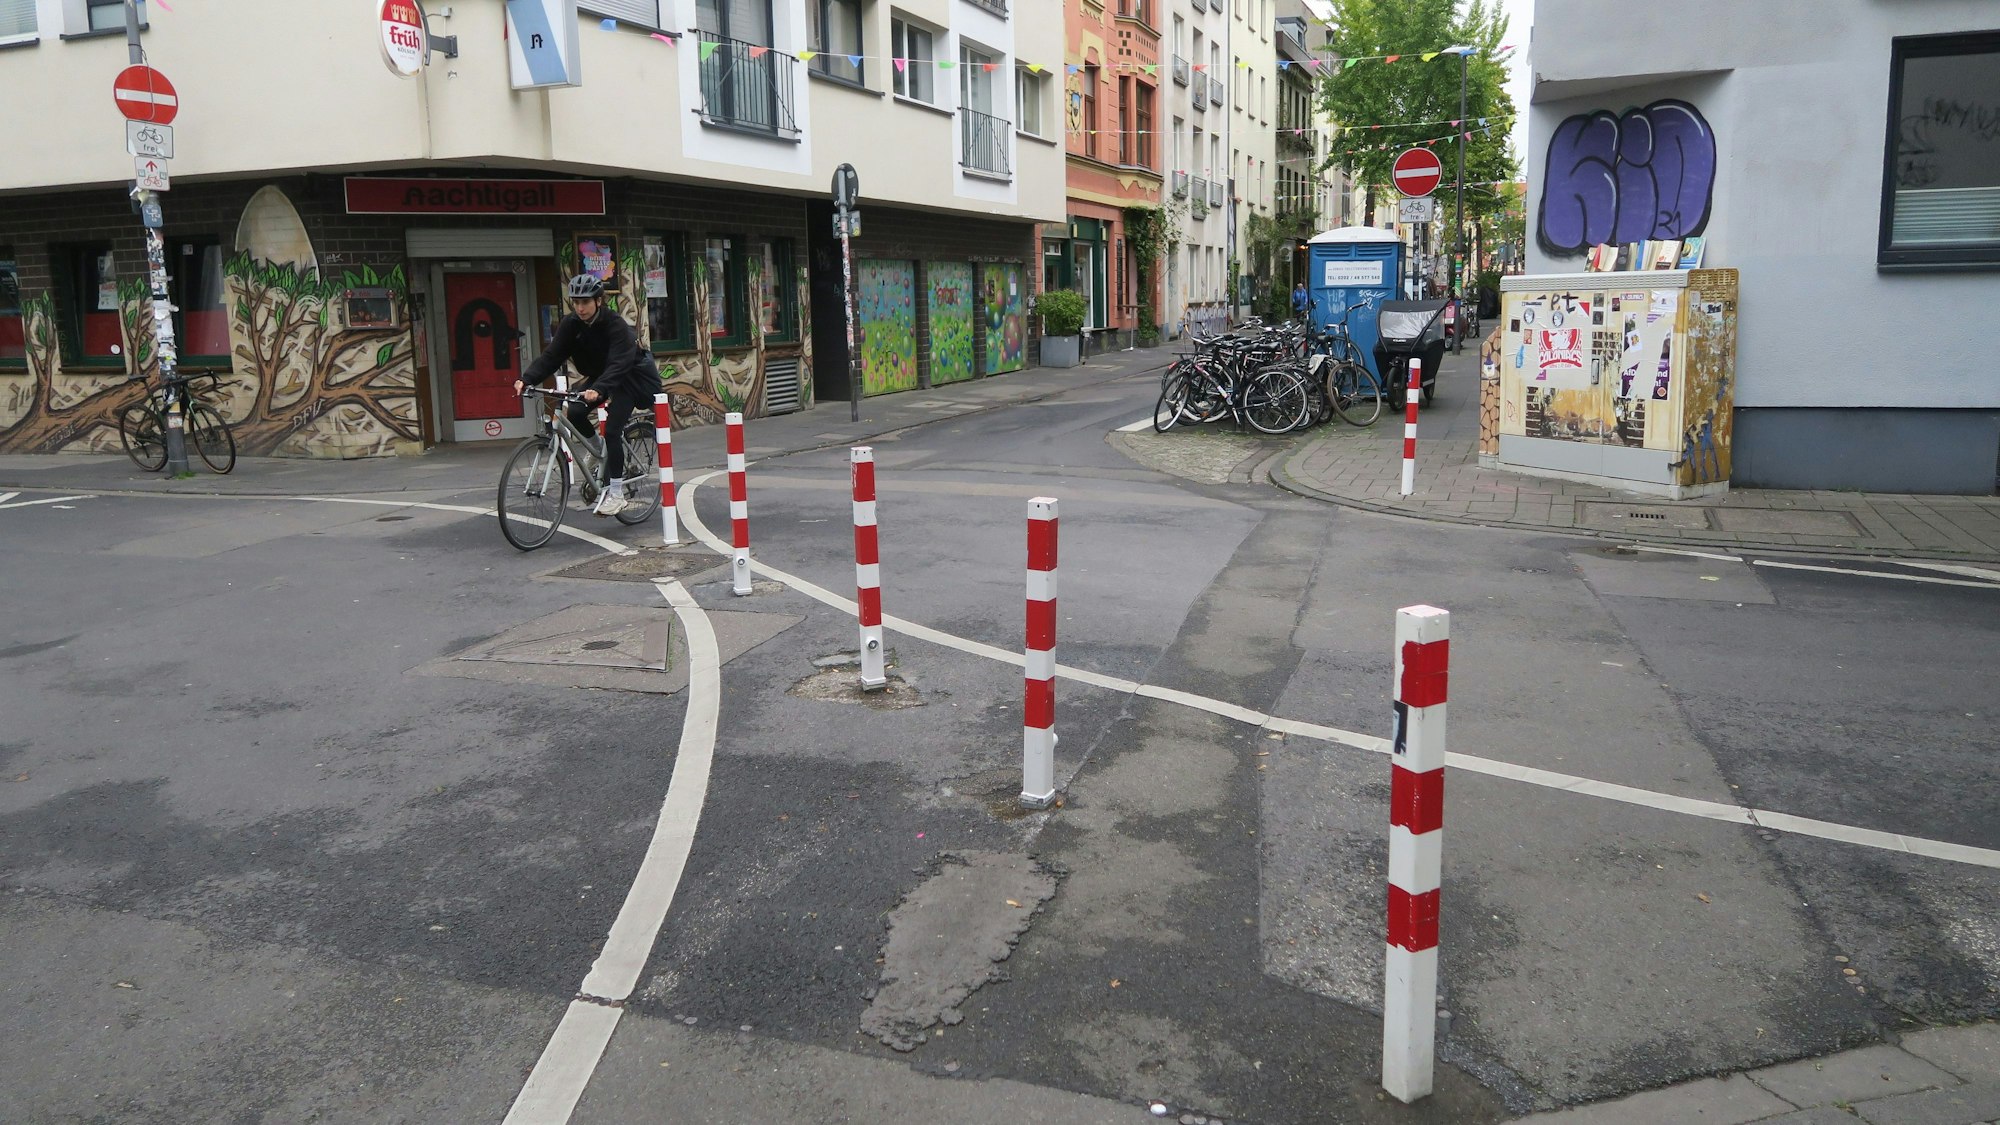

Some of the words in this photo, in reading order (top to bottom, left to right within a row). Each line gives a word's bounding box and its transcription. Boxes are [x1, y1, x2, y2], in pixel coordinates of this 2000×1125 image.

[389, 26, 420, 51] früh
[143, 144, 158, 152] frei
[1539, 349, 1582, 362] COLONIACS
